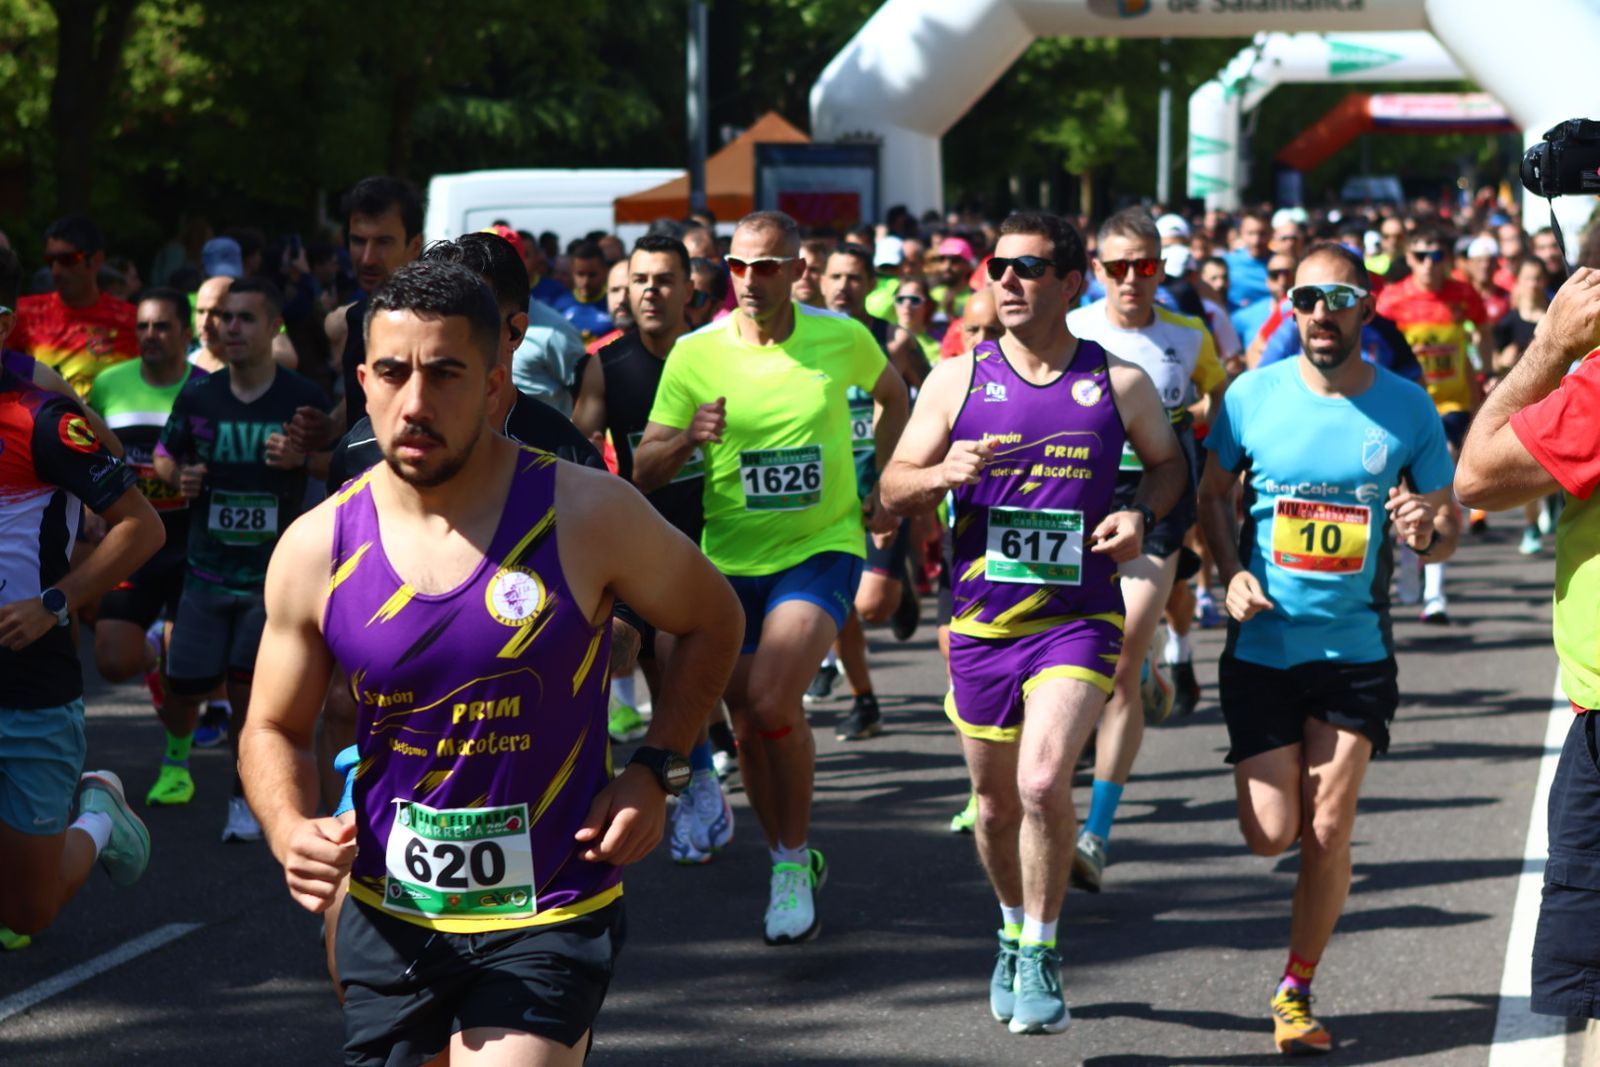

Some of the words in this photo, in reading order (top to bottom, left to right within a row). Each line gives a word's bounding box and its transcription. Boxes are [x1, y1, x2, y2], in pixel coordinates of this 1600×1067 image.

[1044, 445, 1090, 460] PRIM
[745, 463, 820, 494] 1626
[1030, 464, 1092, 479] Macotera
[218, 507, 266, 529] 628
[1001, 529, 1067, 562] 617
[1300, 522, 1342, 555] 10
[451, 695, 521, 725] PRIM
[436, 731, 531, 758] Macotera
[418, 822, 484, 838] CARRERA
[405, 837, 506, 888] 620
